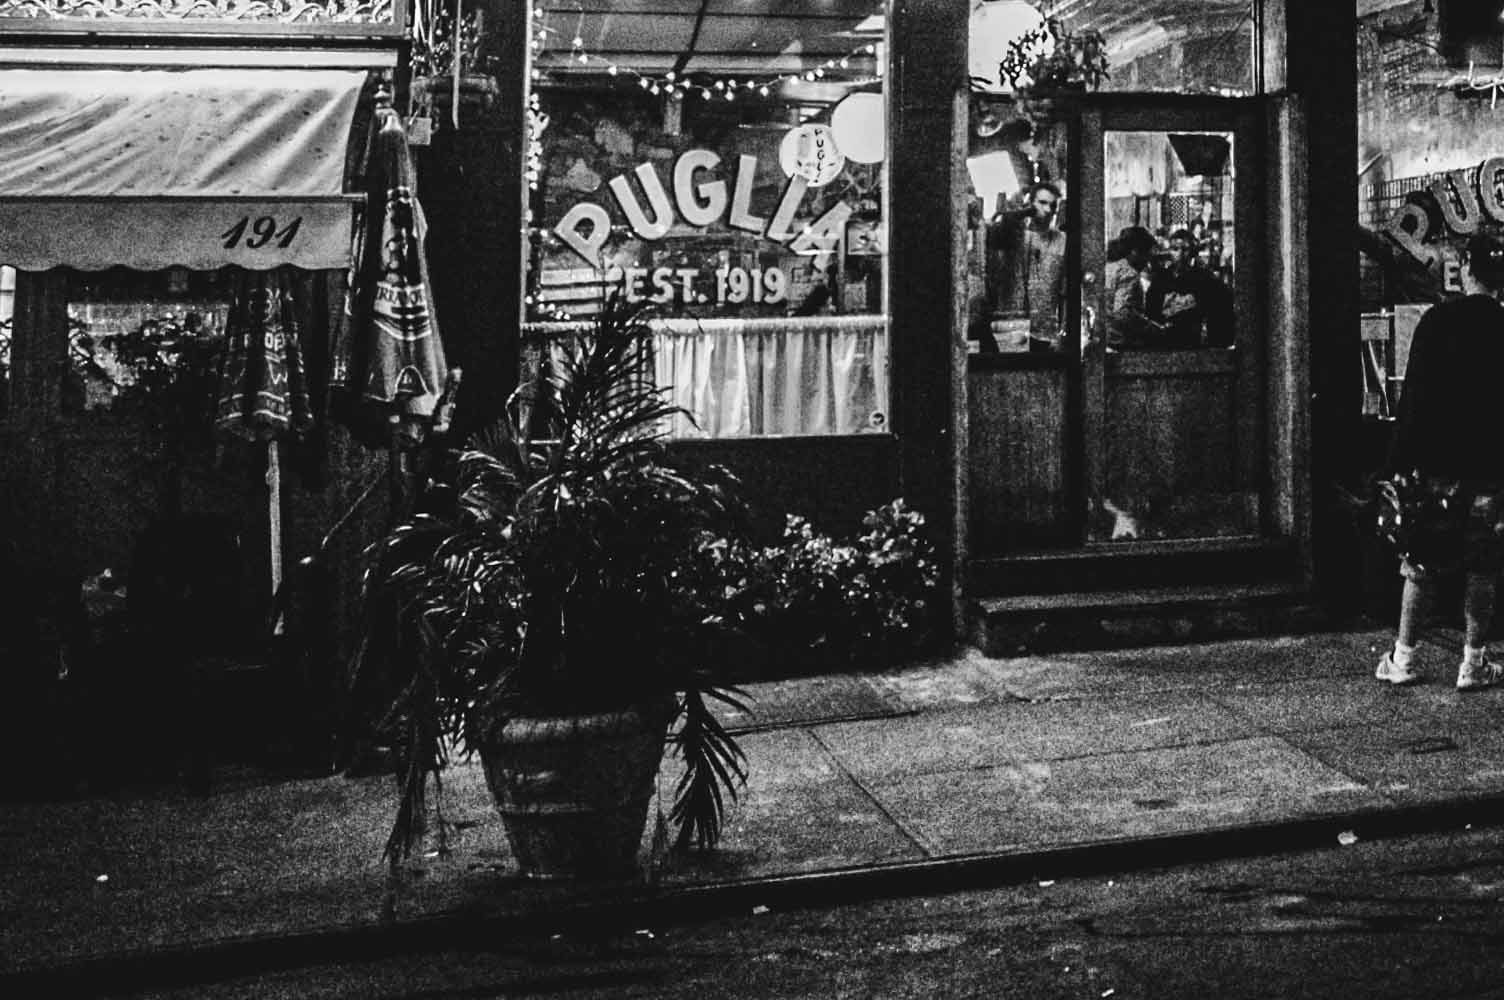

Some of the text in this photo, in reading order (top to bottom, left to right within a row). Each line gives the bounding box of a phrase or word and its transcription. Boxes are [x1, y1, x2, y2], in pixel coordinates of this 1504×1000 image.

[553, 149, 852, 271] PUGLIA
[221, 216, 303, 250] 191
[625, 266, 786, 304] EST. 1919
